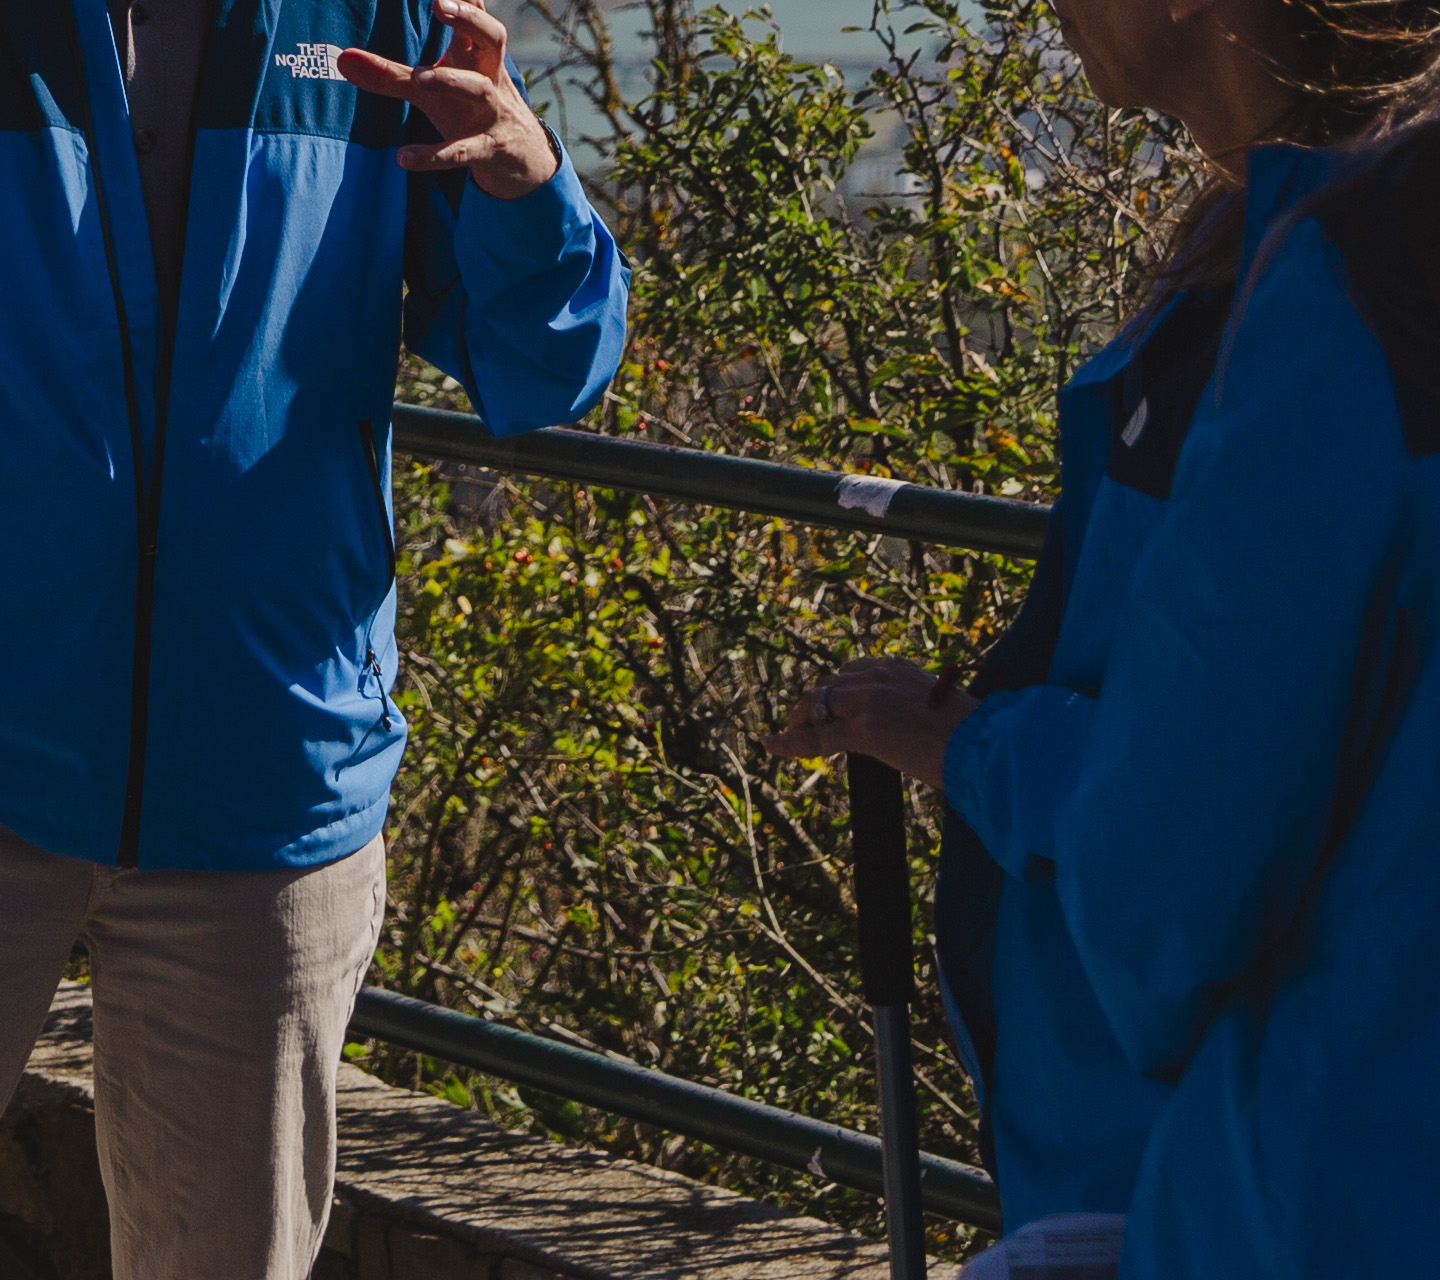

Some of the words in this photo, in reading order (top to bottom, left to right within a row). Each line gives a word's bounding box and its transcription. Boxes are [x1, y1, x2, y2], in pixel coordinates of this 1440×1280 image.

[296, 43, 326, 56] THE
[275, 54, 328, 68] NORTH
[291, 66, 330, 79] FACE
